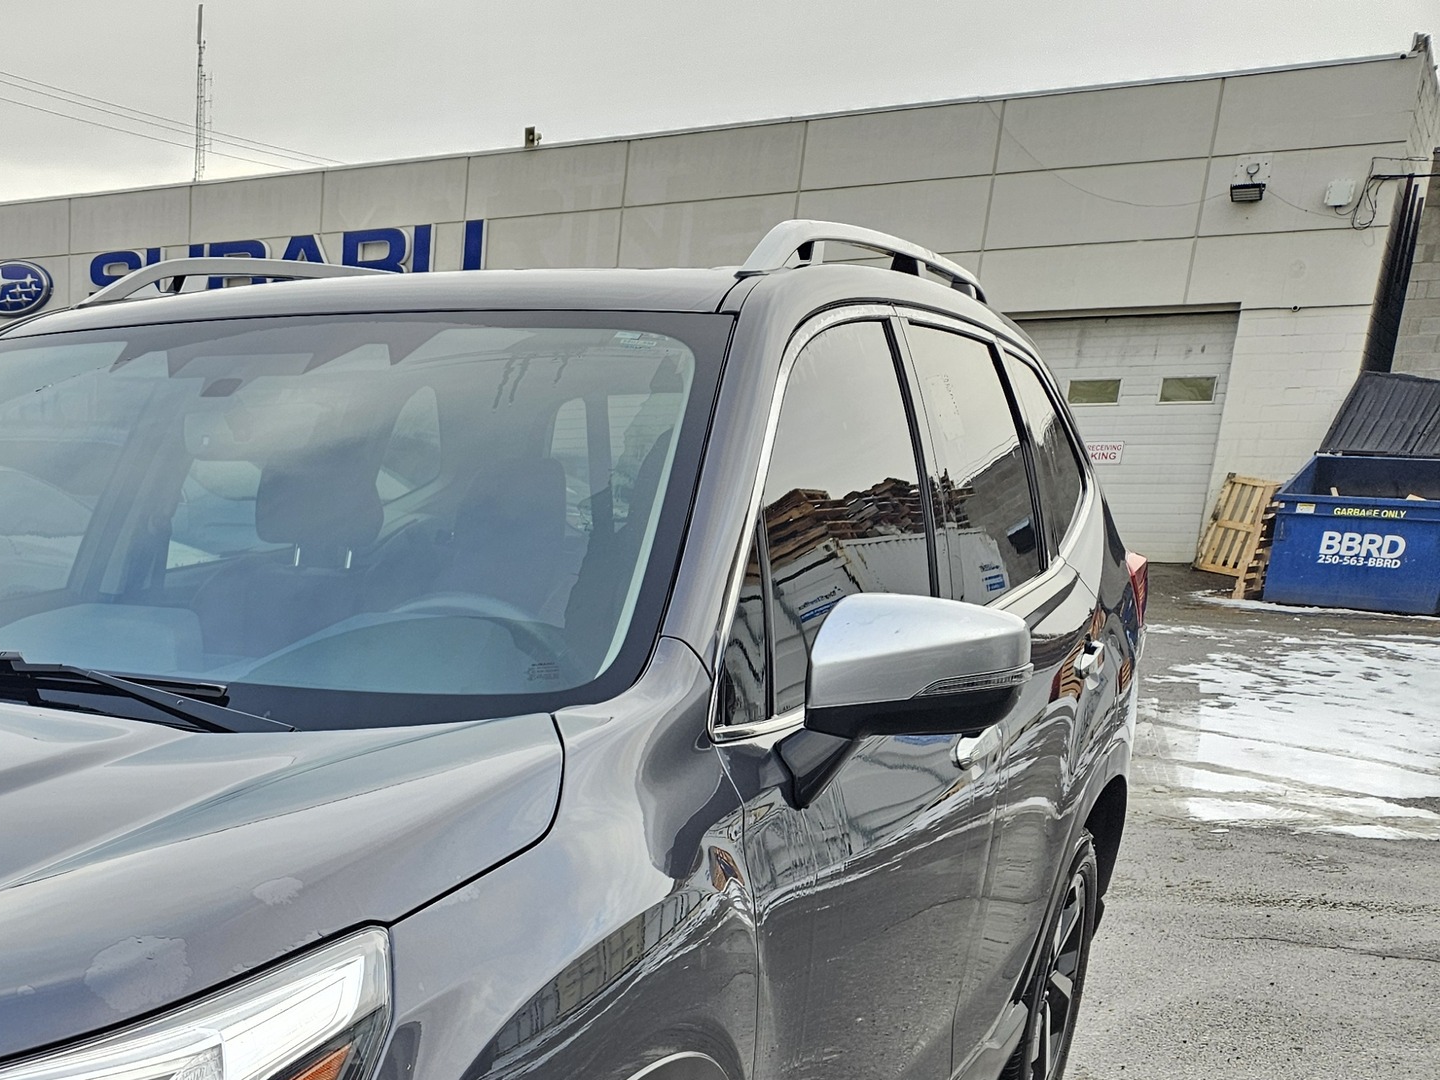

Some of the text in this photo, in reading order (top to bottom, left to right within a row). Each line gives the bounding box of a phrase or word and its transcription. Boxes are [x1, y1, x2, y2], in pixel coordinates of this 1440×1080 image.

[1091, 452, 1117, 460] KING
[1381, 509, 1407, 519] ONLY
[1319, 531, 1406, 559] BBRD
[1317, 554, 1401, 569] 250-563-BBRD
